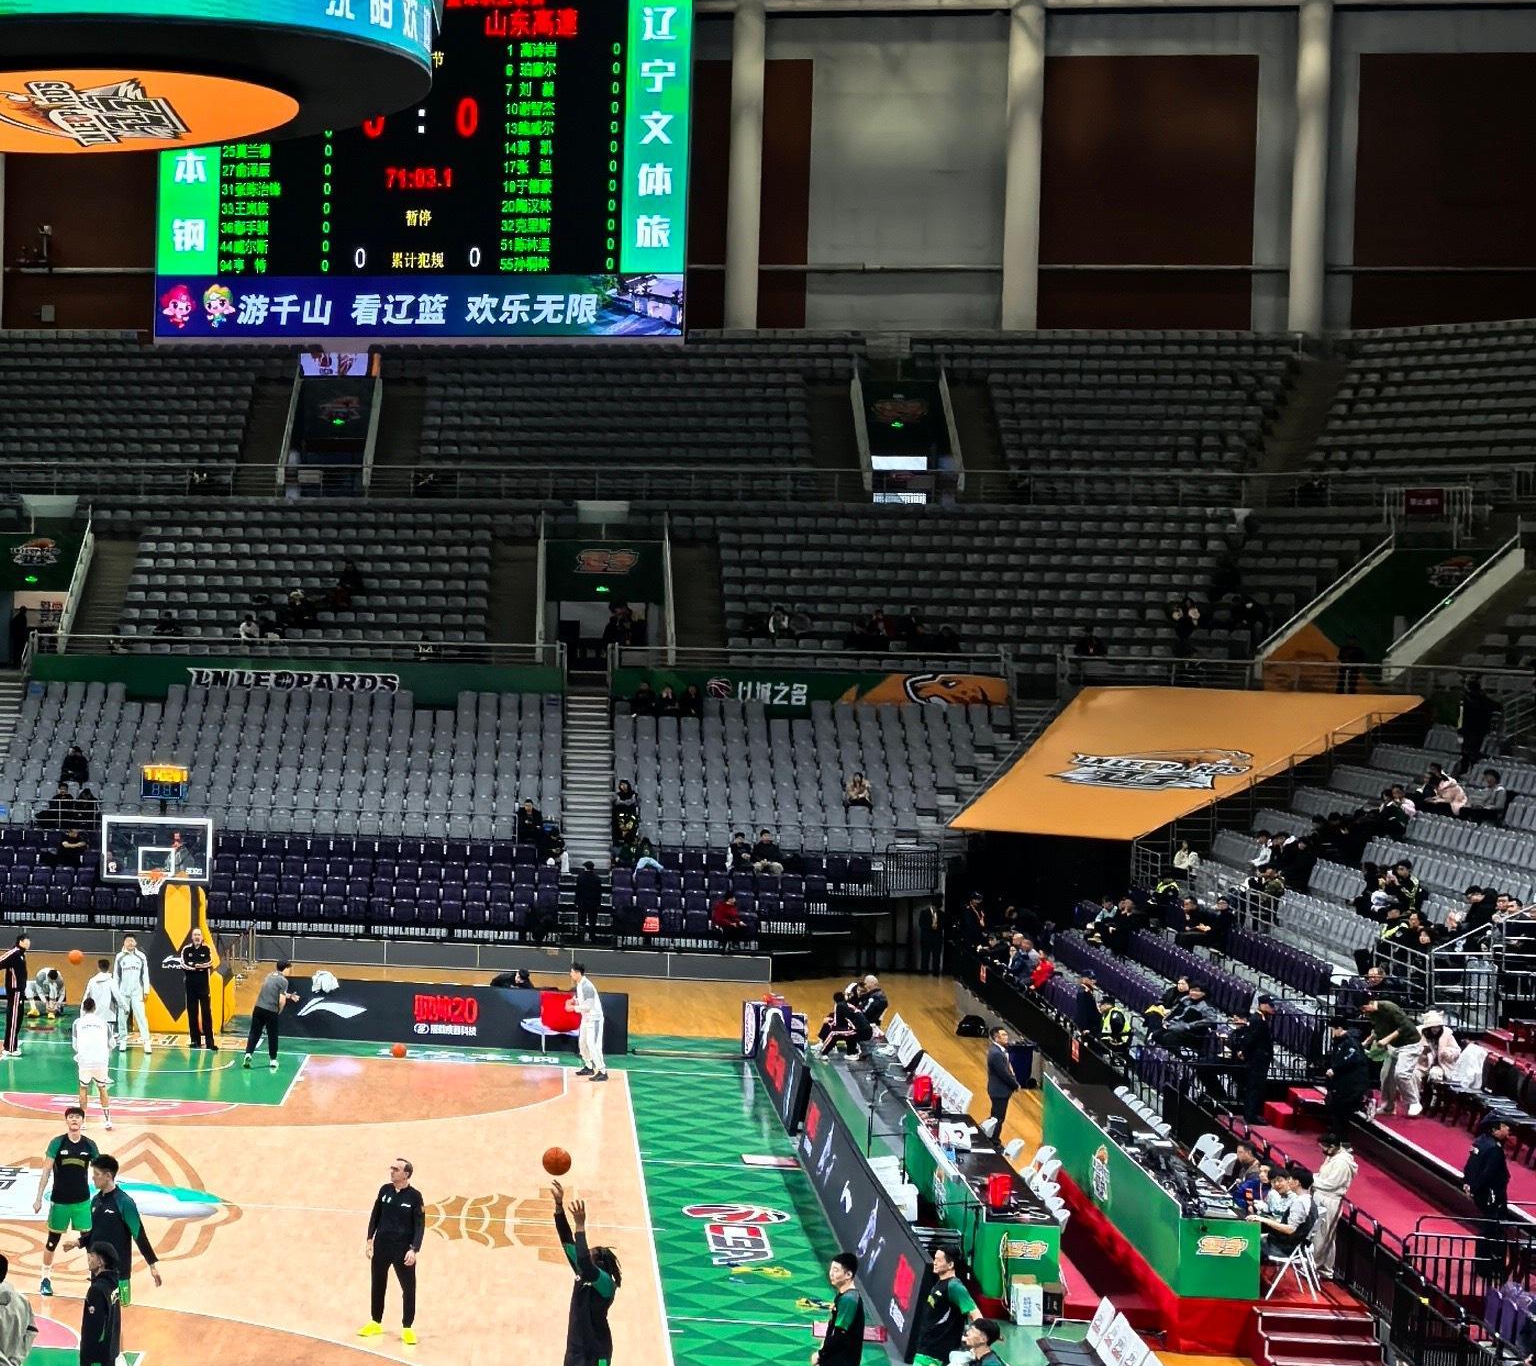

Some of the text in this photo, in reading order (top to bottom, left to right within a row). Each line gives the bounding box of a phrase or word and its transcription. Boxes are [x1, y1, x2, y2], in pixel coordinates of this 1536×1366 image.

[636, 6, 678, 249] 辽宁文体旅
[172, 149, 206, 252] 本钢
[406, 210, 432, 227] 暂停
[355, 247, 480, 269] 0 累计犯规 0
[237, 293, 597, 325] 游千山 看辽篮 欢乐无限
[232, 670, 400, 693] LEOPARDS
